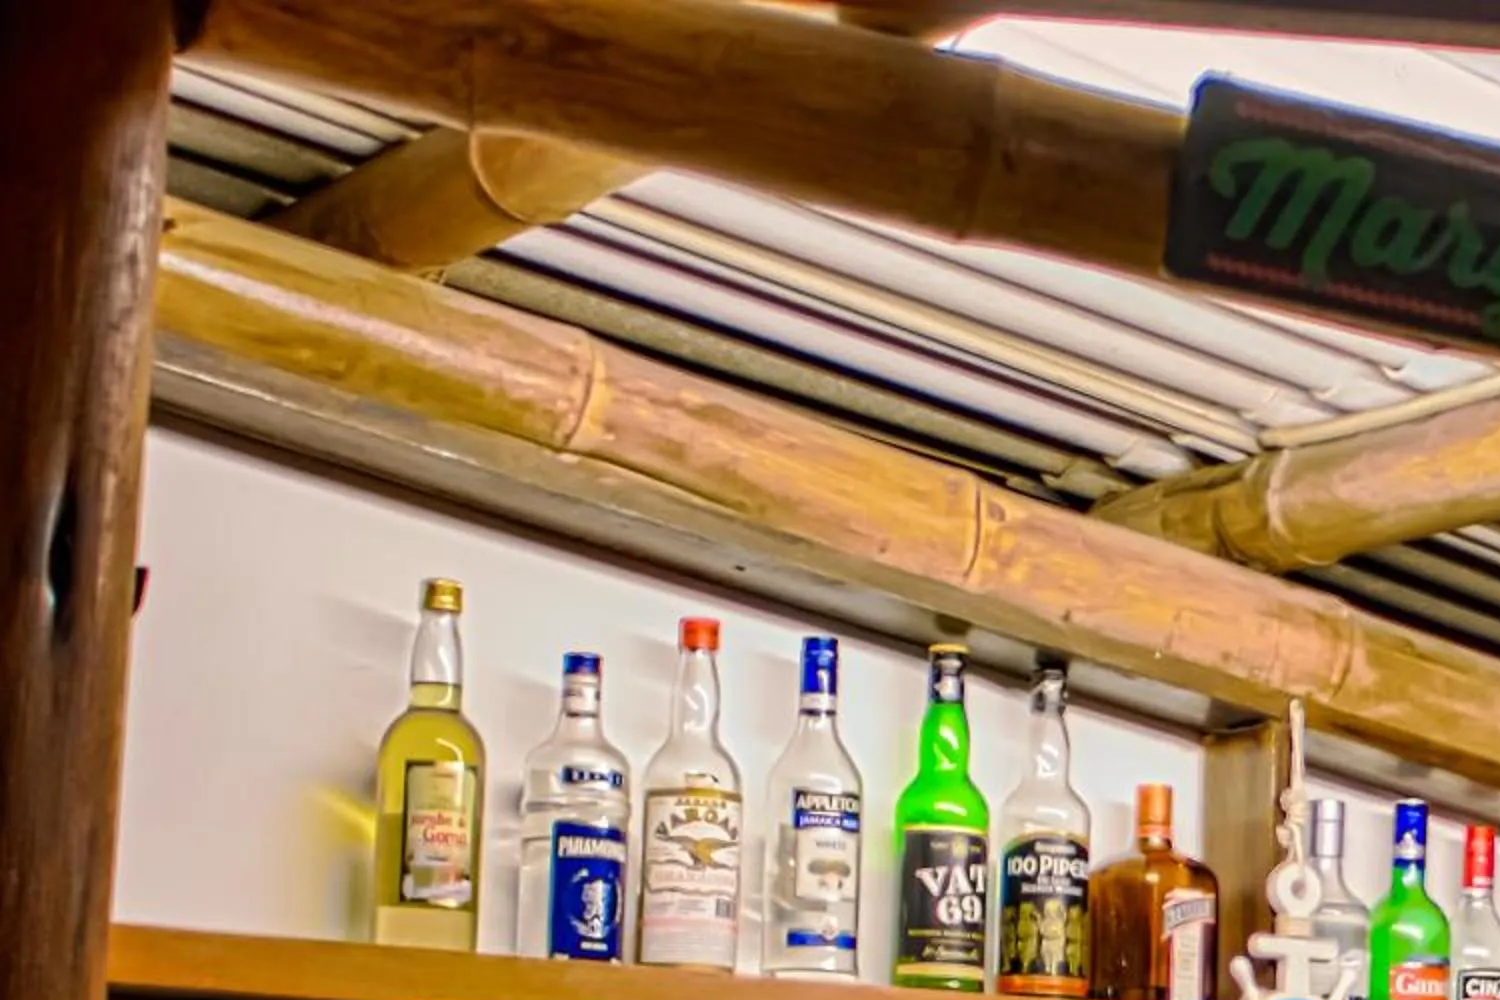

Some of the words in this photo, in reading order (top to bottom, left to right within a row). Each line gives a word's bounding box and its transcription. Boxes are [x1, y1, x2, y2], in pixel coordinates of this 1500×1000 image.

[915, 863, 987, 897] VAT
[1007, 855, 1038, 877] 100
[936, 895, 983, 925] 69
